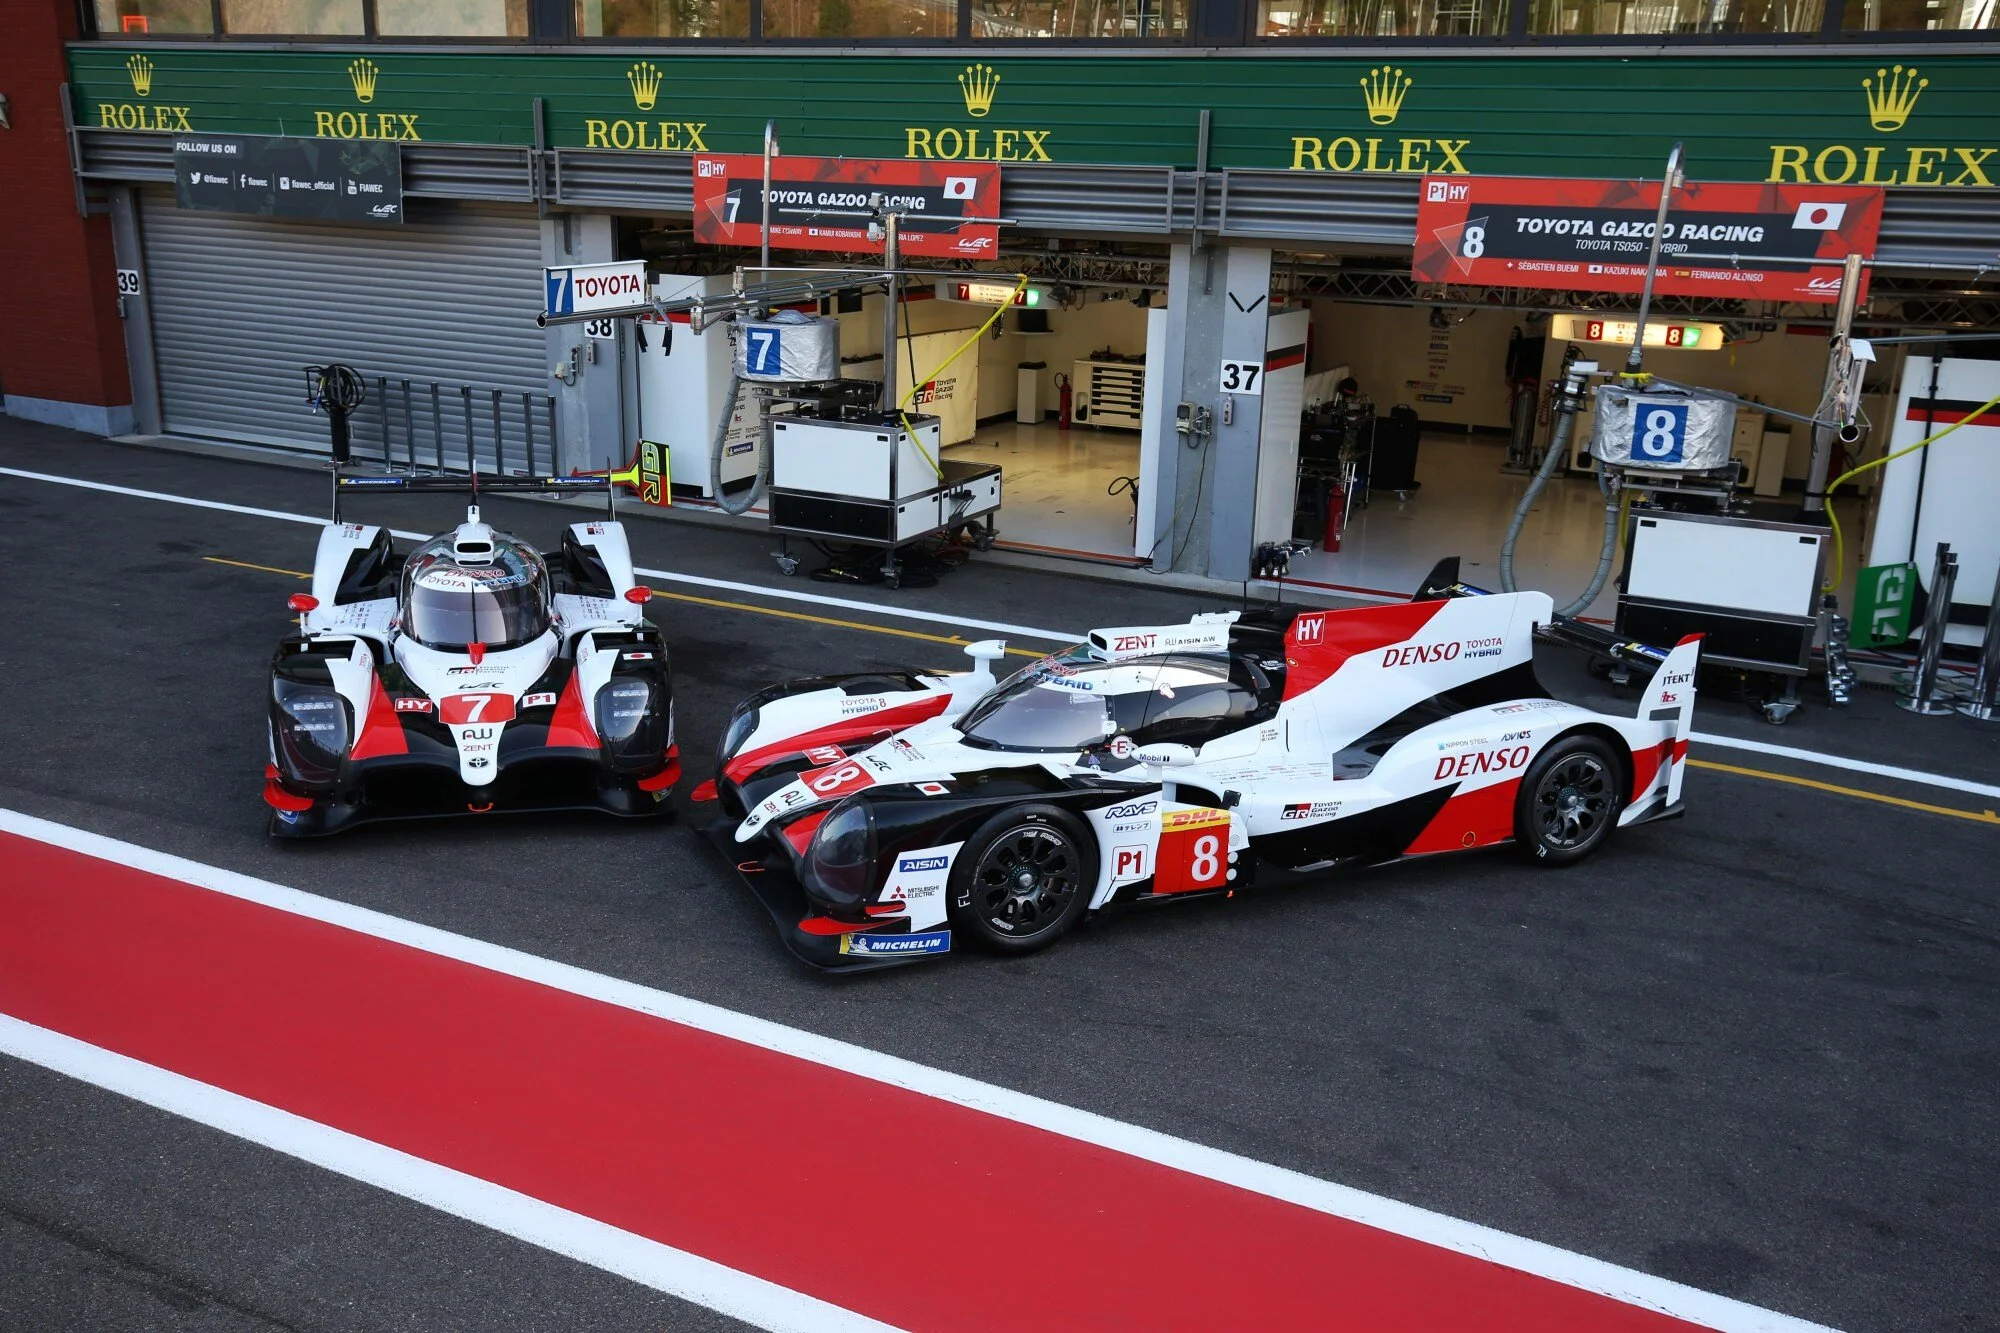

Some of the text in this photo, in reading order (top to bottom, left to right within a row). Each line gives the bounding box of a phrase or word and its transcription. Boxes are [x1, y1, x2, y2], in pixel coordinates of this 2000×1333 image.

[99, 104, 193, 132] ROLEX
[314, 111, 422, 141] ROLEX
[585, 119, 709, 152] ROLEX
[176, 142, 237, 154] FOLLOW US ON
[905, 128, 1052, 163] ROLEX
[1291, 136, 1471, 175] ROLEX
[699, 164, 711, 175] P1
[713, 164, 726, 176] HY
[1765, 145, 1998, 187] ROLEX
[204, 174, 229, 185] @fiawec
[248, 177, 268, 187] fiawec
[292, 179, 335, 191] fiawec_official
[359, 183, 384, 194] FIAWEC
[1430, 185, 1446, 199] P1
[1450, 185, 1469, 200] HY
[817, 192, 867, 208] GAZOO
[726, 197, 741, 223] 7
[770, 226, 782, 234] MIKE
[818, 229, 834, 237] KAMUI
[1516, 217, 1765, 243] TOYOTA GAZOO RACING
[907, 234, 924, 242] LOPEZ
[1462, 226, 1486, 258] 8
[1575, 239, 1611, 250] TOYOTA
[1612, 240, 1643, 252] TS050
[1518, 260, 1579, 273] SÉBASTIEN BUEMI
[1604, 266, 1629, 276] KAZUKI
[118, 272, 139, 292] 39
[1690, 270, 1764, 283] FERNANDO ALONSO
[550, 269, 569, 313] 7
[575, 274, 641, 299] TOYOTA
[960, 285, 968, 298] 7
[586, 318, 613, 337] 38
[1590, 323, 1601, 338] 8
[1669, 329, 1680, 344] 8
[751, 331, 774, 371] 7
[936, 377, 957, 387] TOYOTA
[1222, 363, 1260, 391] 37
[1641, 409, 1678, 457] 8
[641, 442, 662, 504] GR
[444, 568, 506, 578] DENSO
[425, 575, 467, 588] TOYOTA
[1297, 618, 1324, 641] HY
[1113, 634, 1158, 652] ZENT
[1178, 637, 1201, 645] AISIN
[1203, 635, 1216, 643] AW
[1466, 637, 1503, 649] TOYOTA
[1382, 641, 1461, 668] DENSO
[1464, 647, 1503, 659] HYBRID
[399, 700, 429, 711] HY
[527, 694, 551, 705] P1
[840, 697, 875, 707] TOYOTA
[878, 698, 887, 708] 8
[461, 695, 492, 723] 7
[842, 705, 879, 715] HYBRID
[463, 743, 494, 752] ZENT
[1117, 740, 1128, 755] E
[1445, 738, 1489, 749] NIPPON STEEL
[809, 746, 841, 761] HY
[1139, 753, 1162, 762] Mobil
[1434, 745, 1530, 781] DENSO
[813, 765, 861, 792] 8
[763, 801, 781, 814] ZENT
[1104, 800, 1158, 820] RAYS
[1313, 800, 1342, 808] TOYOTA
[1171, 809, 1224, 827] DHL
[1309, 811, 1337, 819] Racing
[1536, 844, 1548, 858] RL
[903, 858, 945, 870] AISIN
[1117, 850, 1142, 876] P1
[1191, 834, 1220, 882] 8
[907, 884, 940, 894] MITSUBISHI
[907, 889, 935, 899] ELECTRIC
[957, 888, 971, 908] FL
[871, 938, 942, 950] MICHELIN
